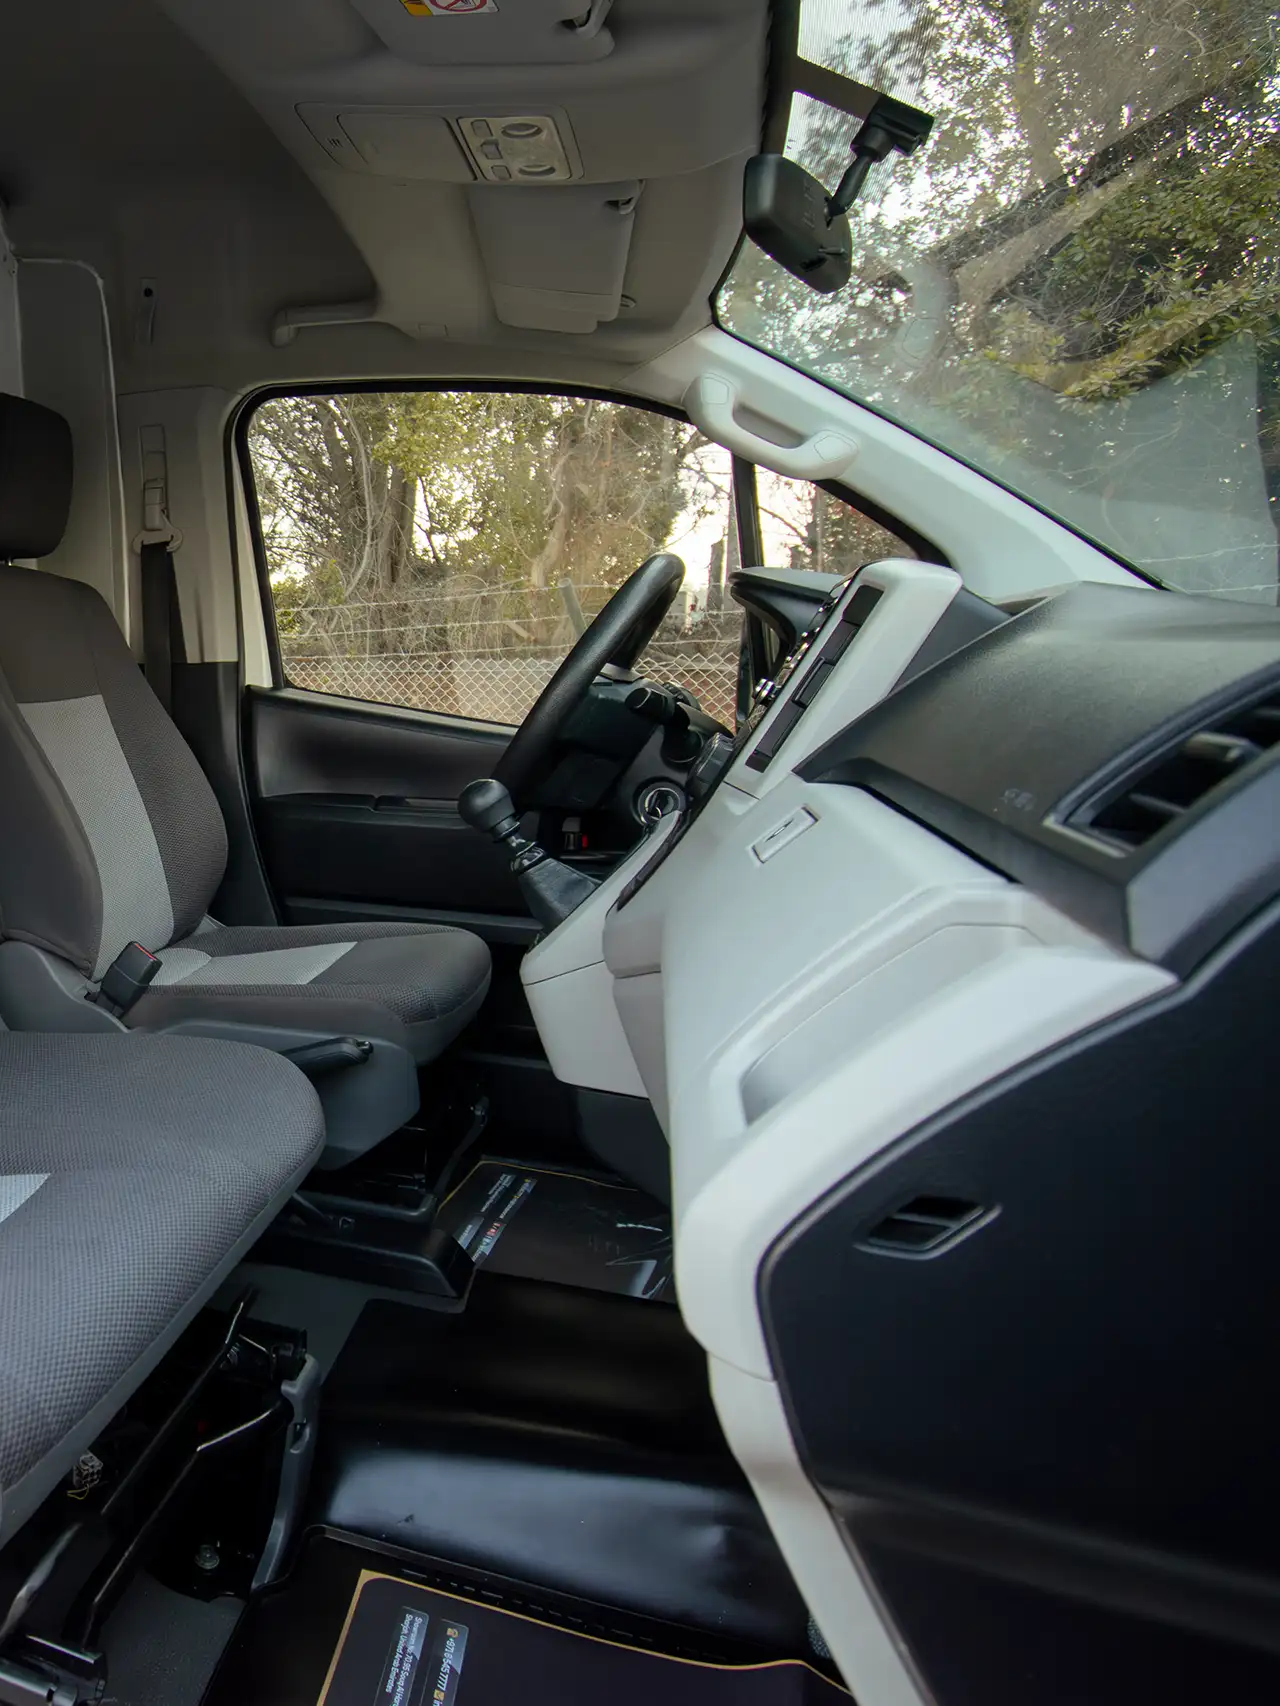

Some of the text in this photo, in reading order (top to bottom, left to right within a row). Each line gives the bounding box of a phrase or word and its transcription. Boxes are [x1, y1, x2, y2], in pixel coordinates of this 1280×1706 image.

[396, 1634, 407, 1653] United
[445, 1637, 455, 1653] +971
[440, 1658, 451, 1673] 545
[385, 1667, 398, 1693] Emirates
